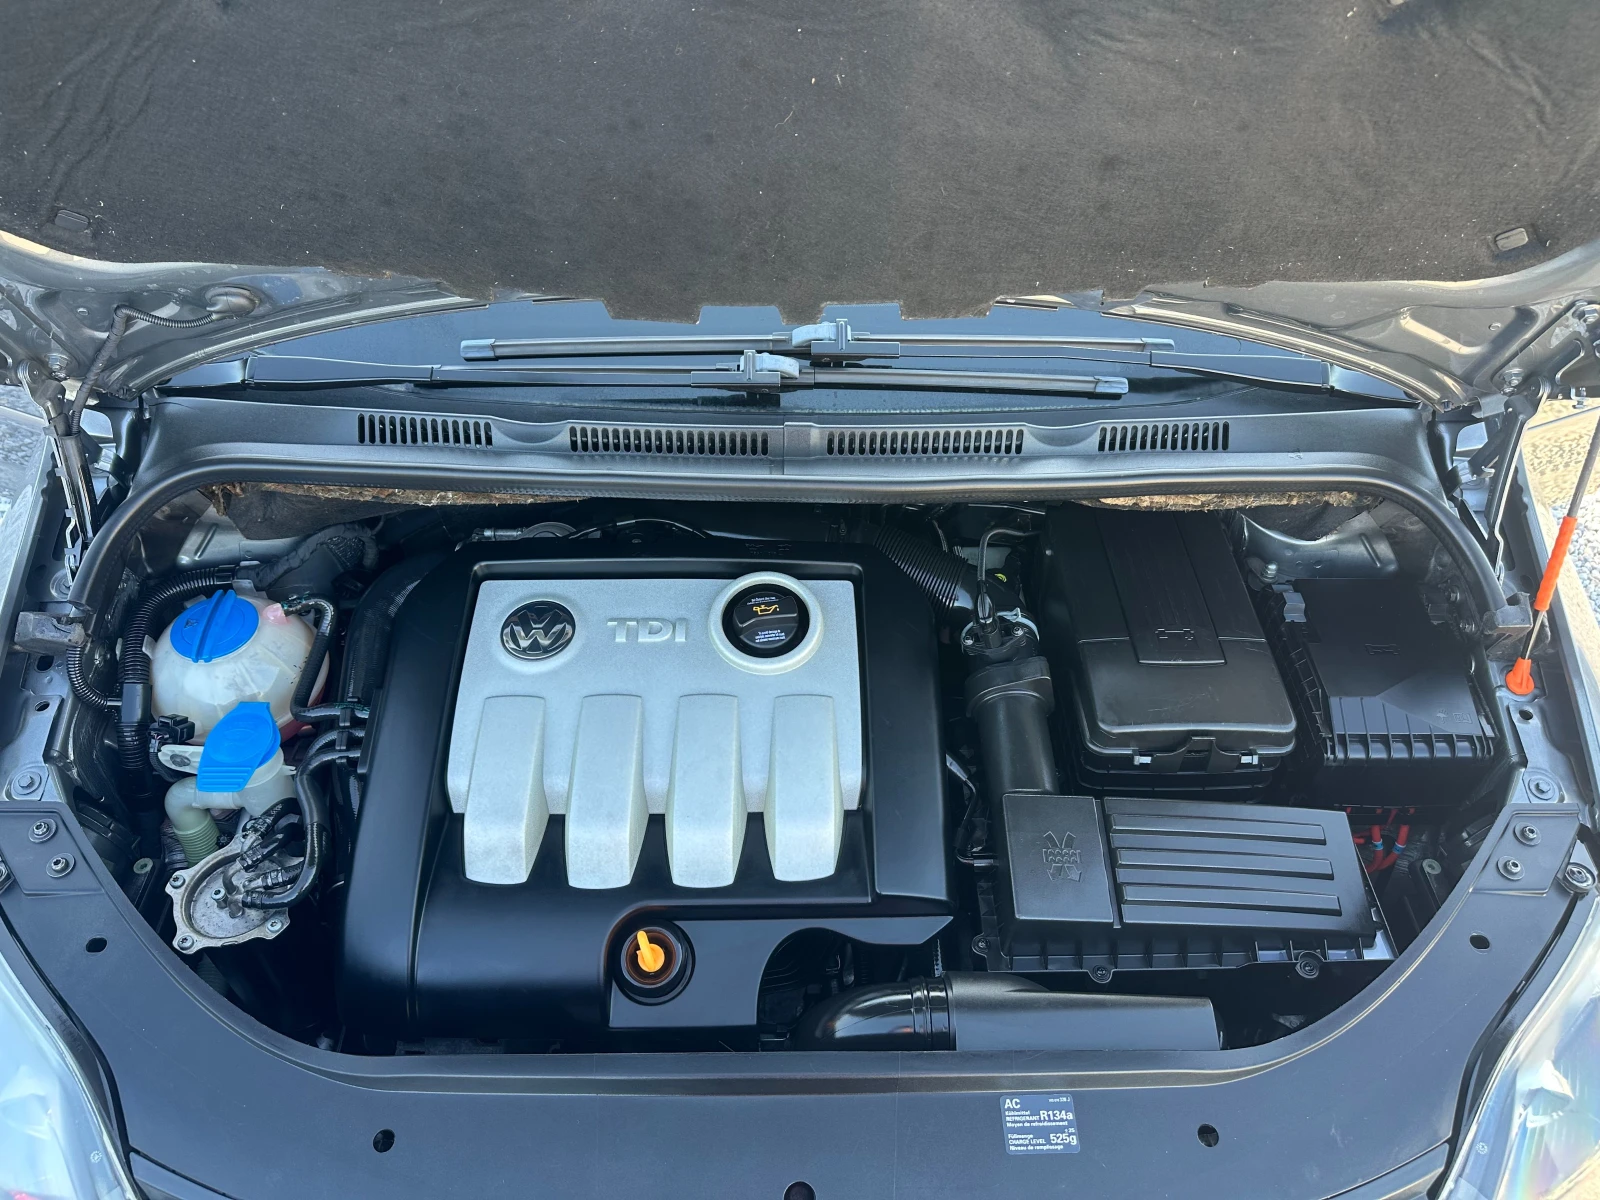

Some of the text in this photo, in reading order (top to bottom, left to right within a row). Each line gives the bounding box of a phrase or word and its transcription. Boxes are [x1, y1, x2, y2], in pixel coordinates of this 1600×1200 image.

[606, 617, 688, 643] TDI
[1004, 1098, 1021, 1109] AC
[1040, 1110, 1074, 1120] R134a
[1050, 1133, 1077, 1145] 525g
